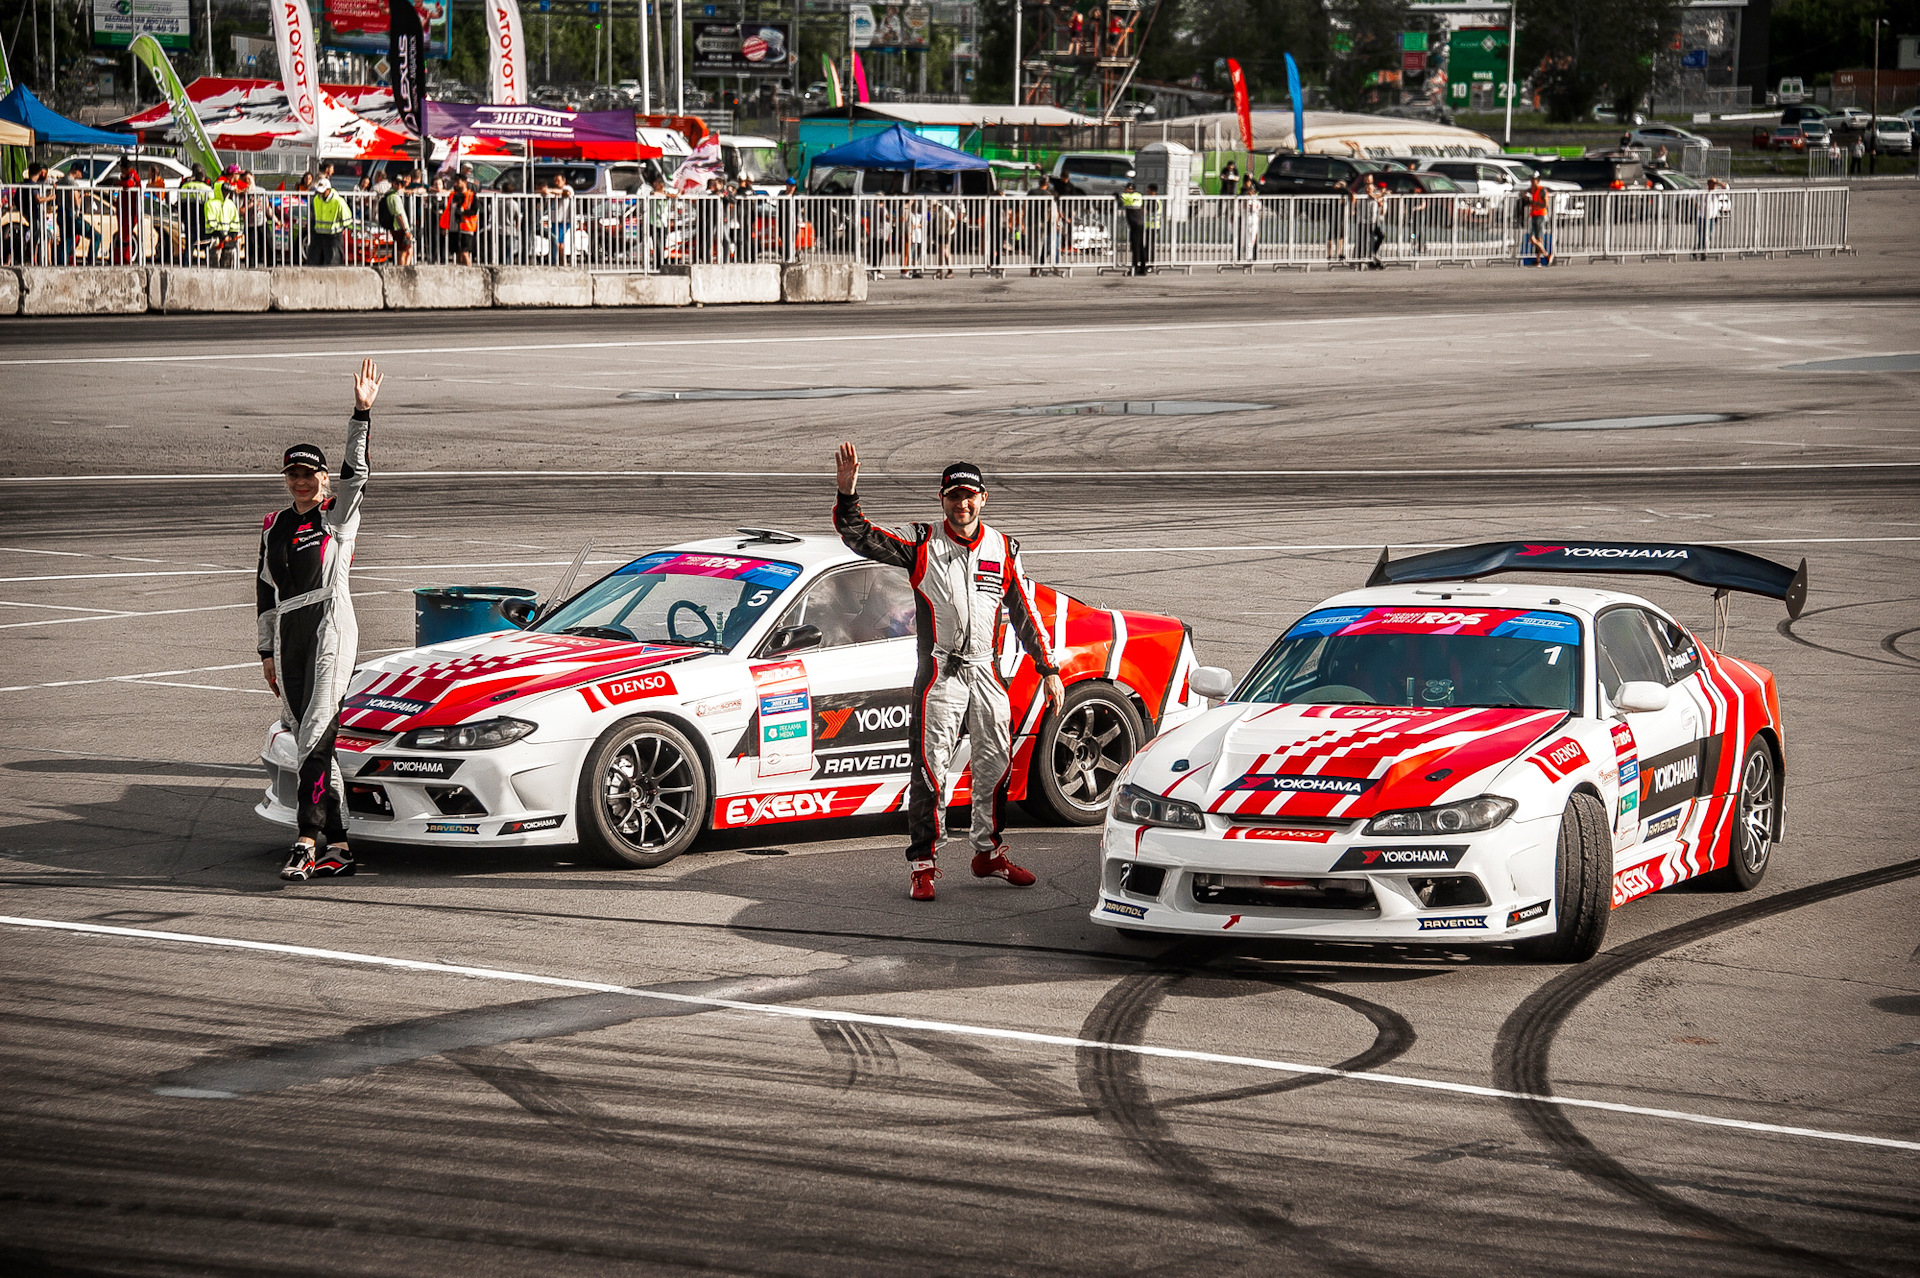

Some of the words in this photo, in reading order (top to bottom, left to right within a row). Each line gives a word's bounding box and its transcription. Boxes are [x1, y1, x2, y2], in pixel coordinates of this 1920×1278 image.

[398, 34, 412, 113] LEXUS
[1452, 82, 1467, 98] 10
[492, 112, 562, 127] ЭНЕРГИЯ
[290, 451, 320, 462] YOKOHAMA
[950, 472, 980, 482] YOKOHAMA
[1563, 547, 1689, 559] YOKOHAMA
[700, 557, 751, 570] RDS
[747, 589, 774, 607] 5
[1416, 611, 1490, 625] RDS
[1656, 619, 1674, 648] 1
[1543, 645, 1563, 666] 1
[611, 675, 666, 697] DENSO
[365, 697, 424, 714] YOKOHAMA
[1343, 707, 1433, 718] DENSO
[1550, 741, 1581, 766] DENSO
[392, 760, 444, 773] YOKOHAMA
[824, 753, 914, 774] RAVENO
[1654, 755, 1698, 794] YOKOHAMA
[1272, 778, 1363, 794] YOKOHAMA
[726, 790, 838, 826] EXEDY
[429, 824, 475, 833] RAVENOL
[522, 819, 557, 829] YOKOHAMA
[1648, 815, 1679, 837] RAVENOL
[1255, 830, 1325, 838] DENSO
[1381, 849, 1449, 863] YOKOHAMA
[1612, 863, 1654, 905] EXEDY
[1105, 902, 1144, 917] RAVENOL
[1519, 906, 1543, 919] YOKOHAMA
[1423, 919, 1484, 928] RAVENOL
